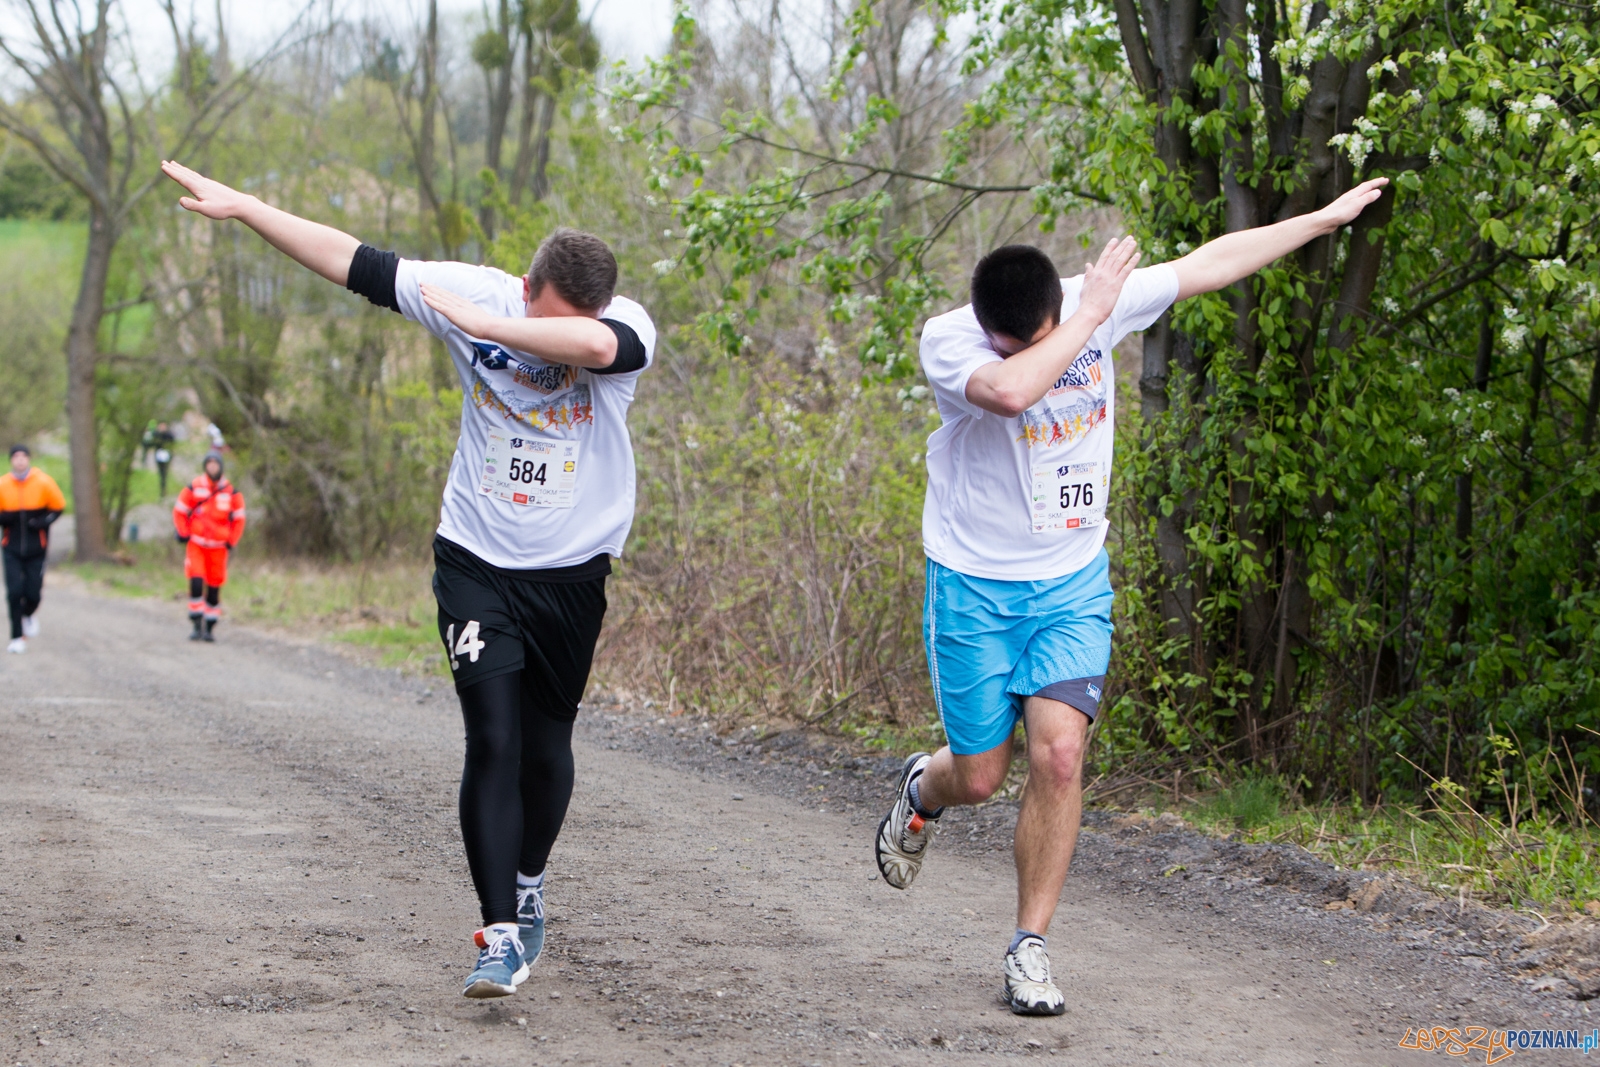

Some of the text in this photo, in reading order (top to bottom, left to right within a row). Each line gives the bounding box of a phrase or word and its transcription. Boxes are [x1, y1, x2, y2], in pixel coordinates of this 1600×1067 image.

[1088, 361, 1101, 386] IV
[509, 457, 547, 486] 584
[1060, 483, 1093, 509] 576
